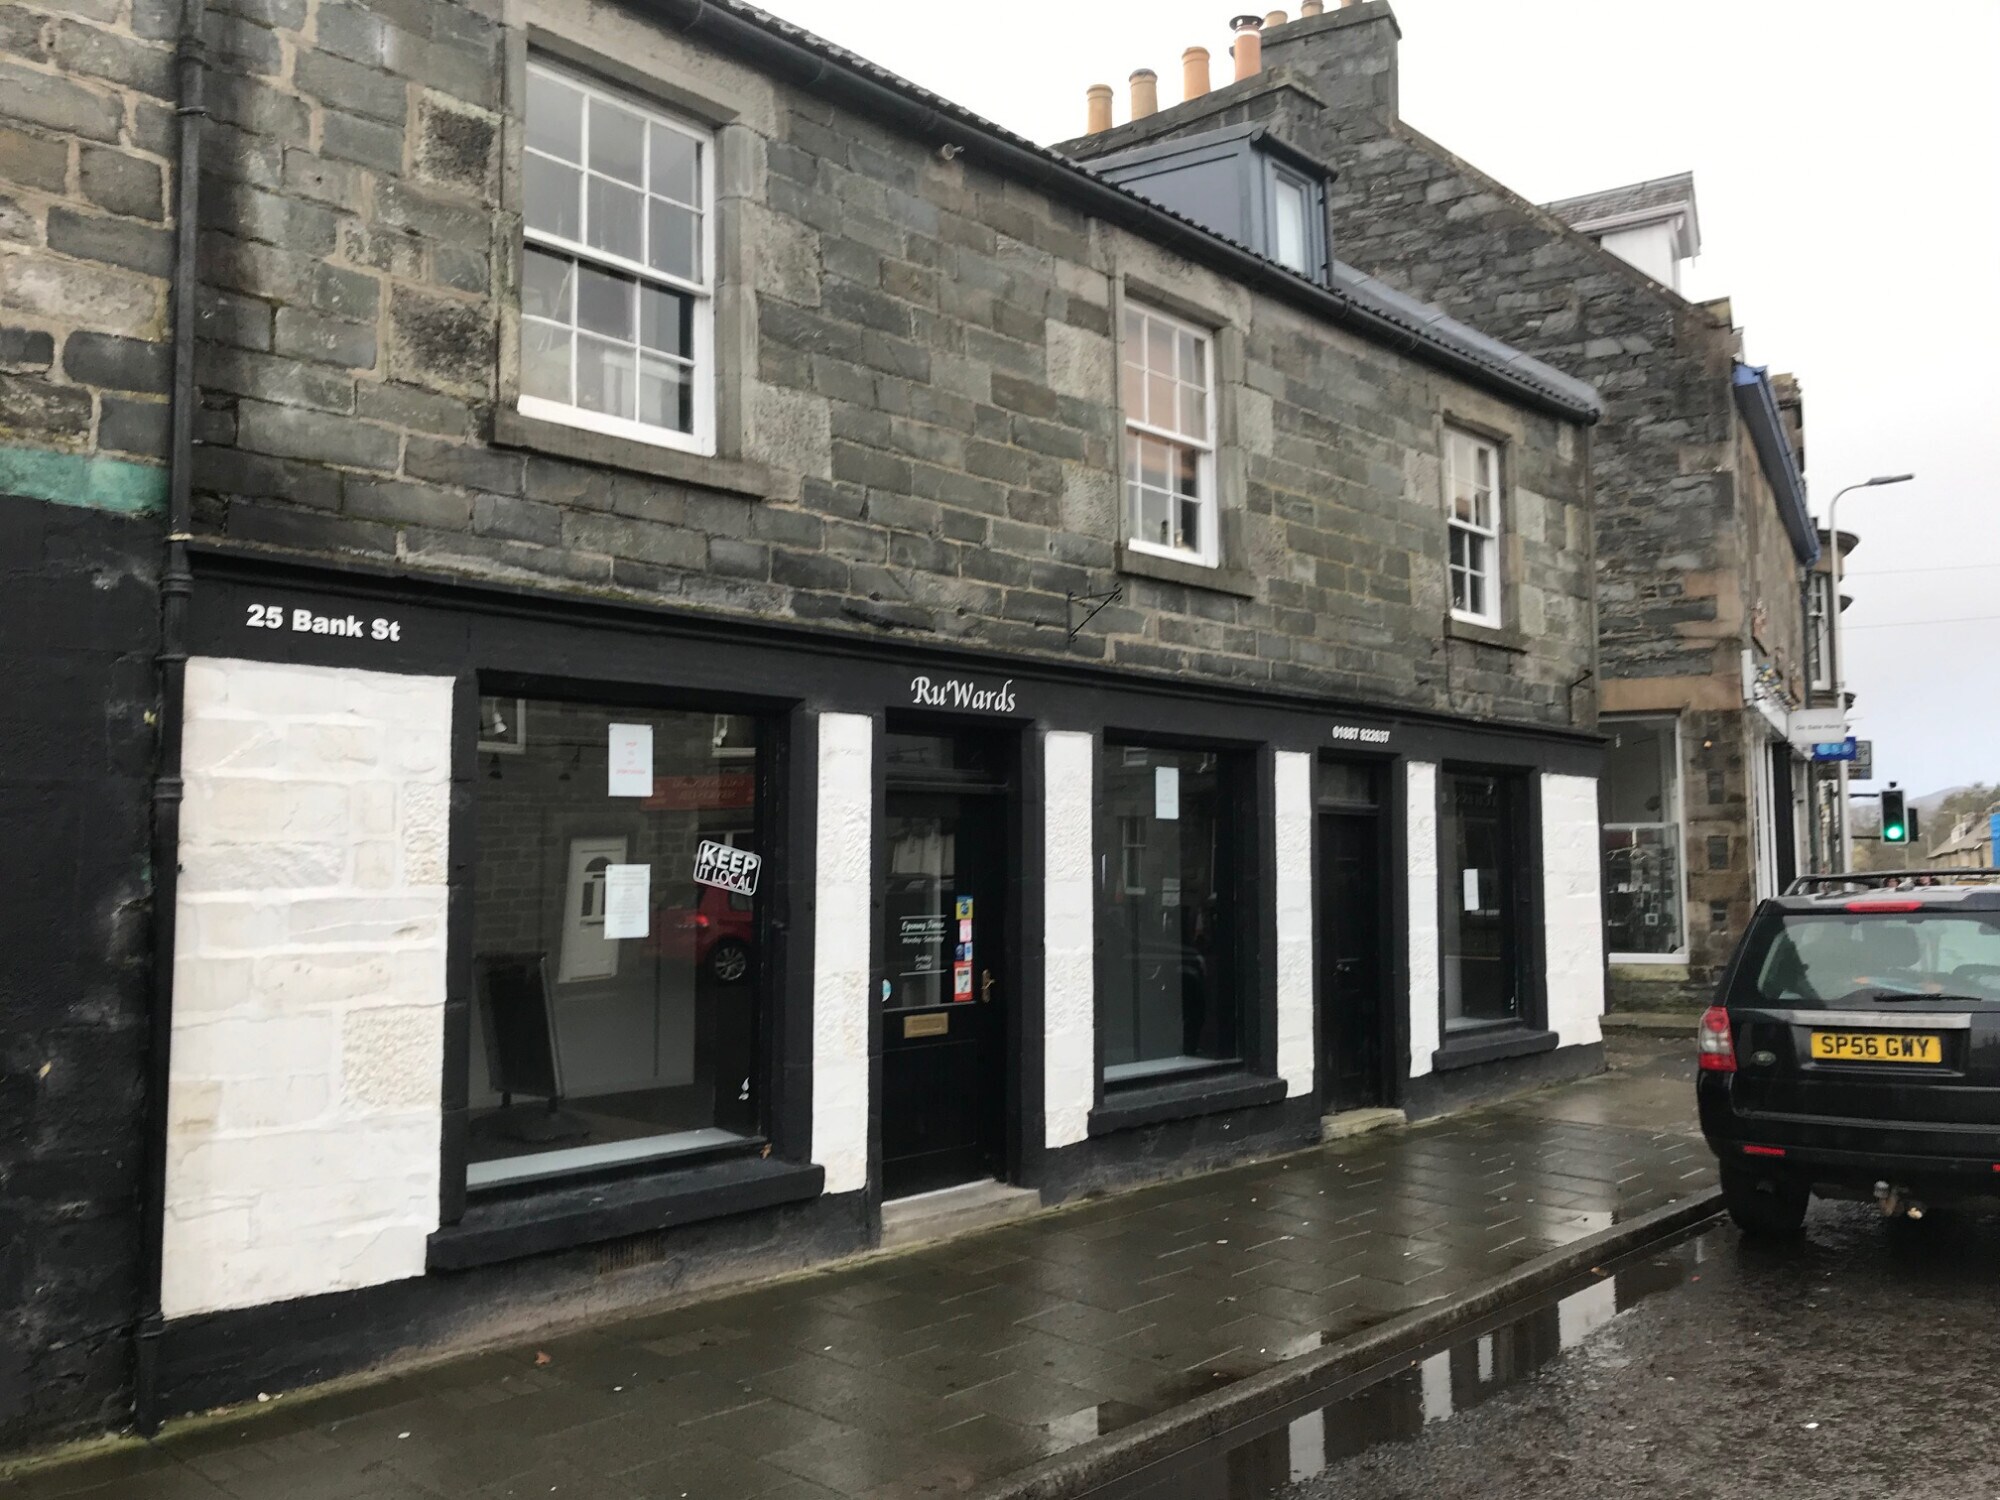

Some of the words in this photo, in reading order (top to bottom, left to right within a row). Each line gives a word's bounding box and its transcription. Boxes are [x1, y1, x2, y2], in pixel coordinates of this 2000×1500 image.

[246, 604, 284, 629] 25
[292, 608, 364, 638] Bank
[370, 618, 401, 642] St
[701, 844, 758, 876] KEEP
[698, 864, 712, 880] IT
[712, 868, 752, 892] LOCAL
[1821, 1036, 1879, 1056] SP56
[1886, 1037, 1929, 1057] GWY
